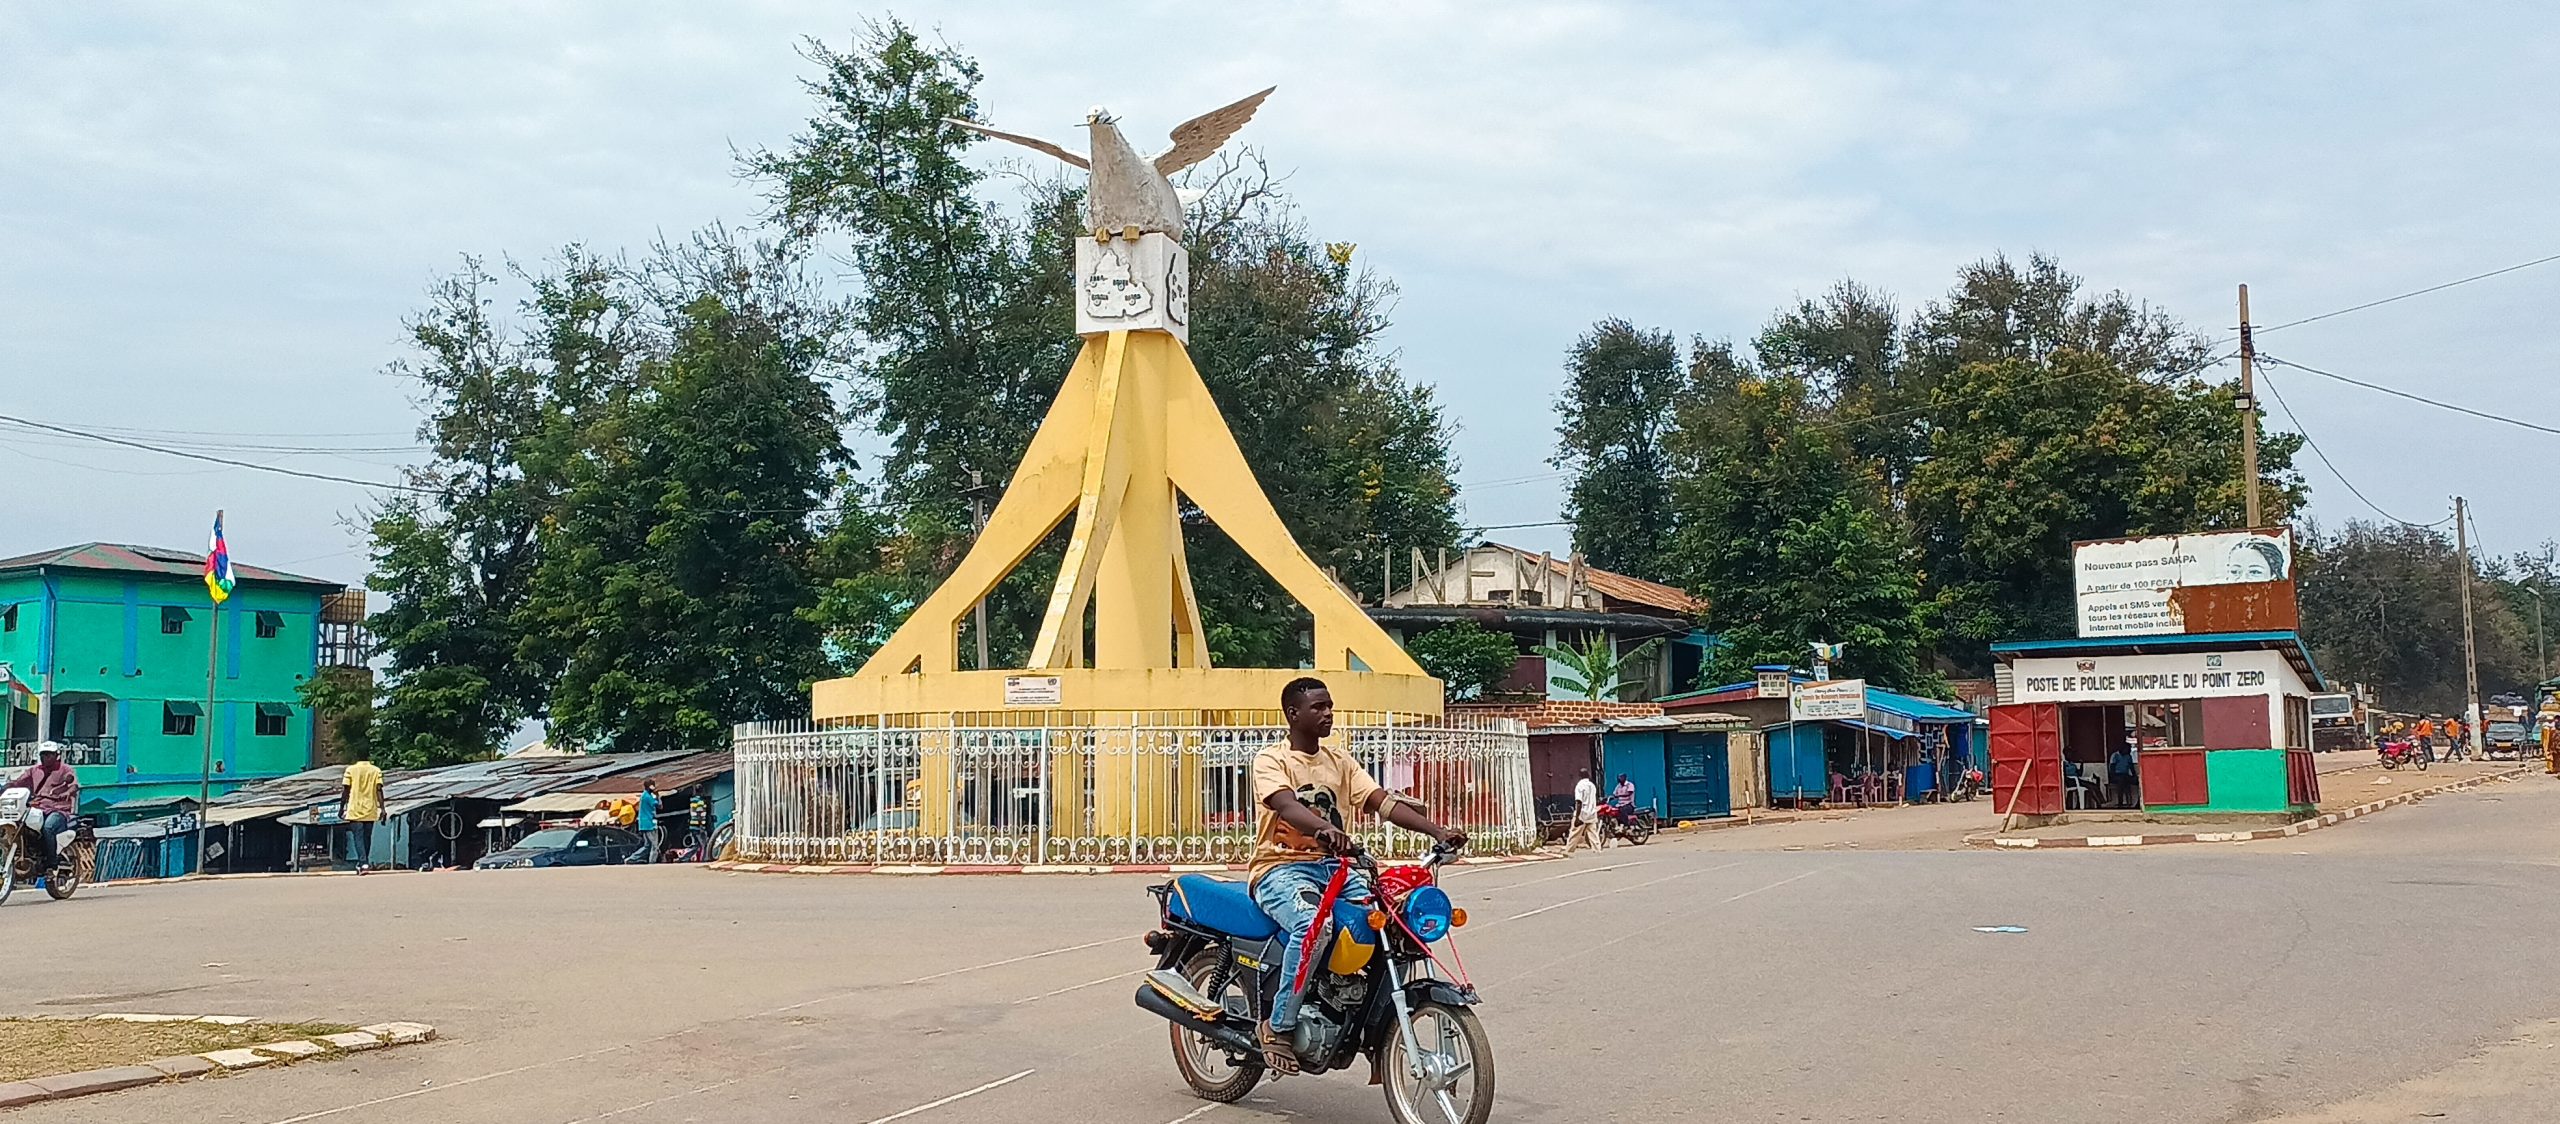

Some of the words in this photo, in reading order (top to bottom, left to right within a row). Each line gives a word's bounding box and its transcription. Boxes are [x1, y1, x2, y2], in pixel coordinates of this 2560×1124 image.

[2084, 562, 2133, 571] Nouveaux
[2135, 560, 2158, 569] pass
[2161, 555, 2197, 565] SAKPA
[2095, 583, 2118, 593] partir
[2134, 580, 2149, 588] 100
[2150, 579, 2174, 587] FCFA
[2088, 602, 2117, 612] Appels
[2129, 600, 2150, 609] SMS
[2152, 600, 2169, 608] ver
[2088, 614, 2107, 622] tous
[2109, 612, 2121, 621] les
[2124, 611, 2158, 620] réseaux
[2089, 622, 2122, 632] Internet
[2124, 620, 2154, 630] mobile
[2026, 677, 2059, 692] POSTE
[2063, 676, 2077, 691] DE
[2080, 675, 2115, 691] POLICE
[2119, 673, 2179, 690] MUNICIPALE
[2183, 673, 2197, 689] DU
[2202, 671, 2231, 688] POINT
[2237, 670, 2265, 687] ZERO
